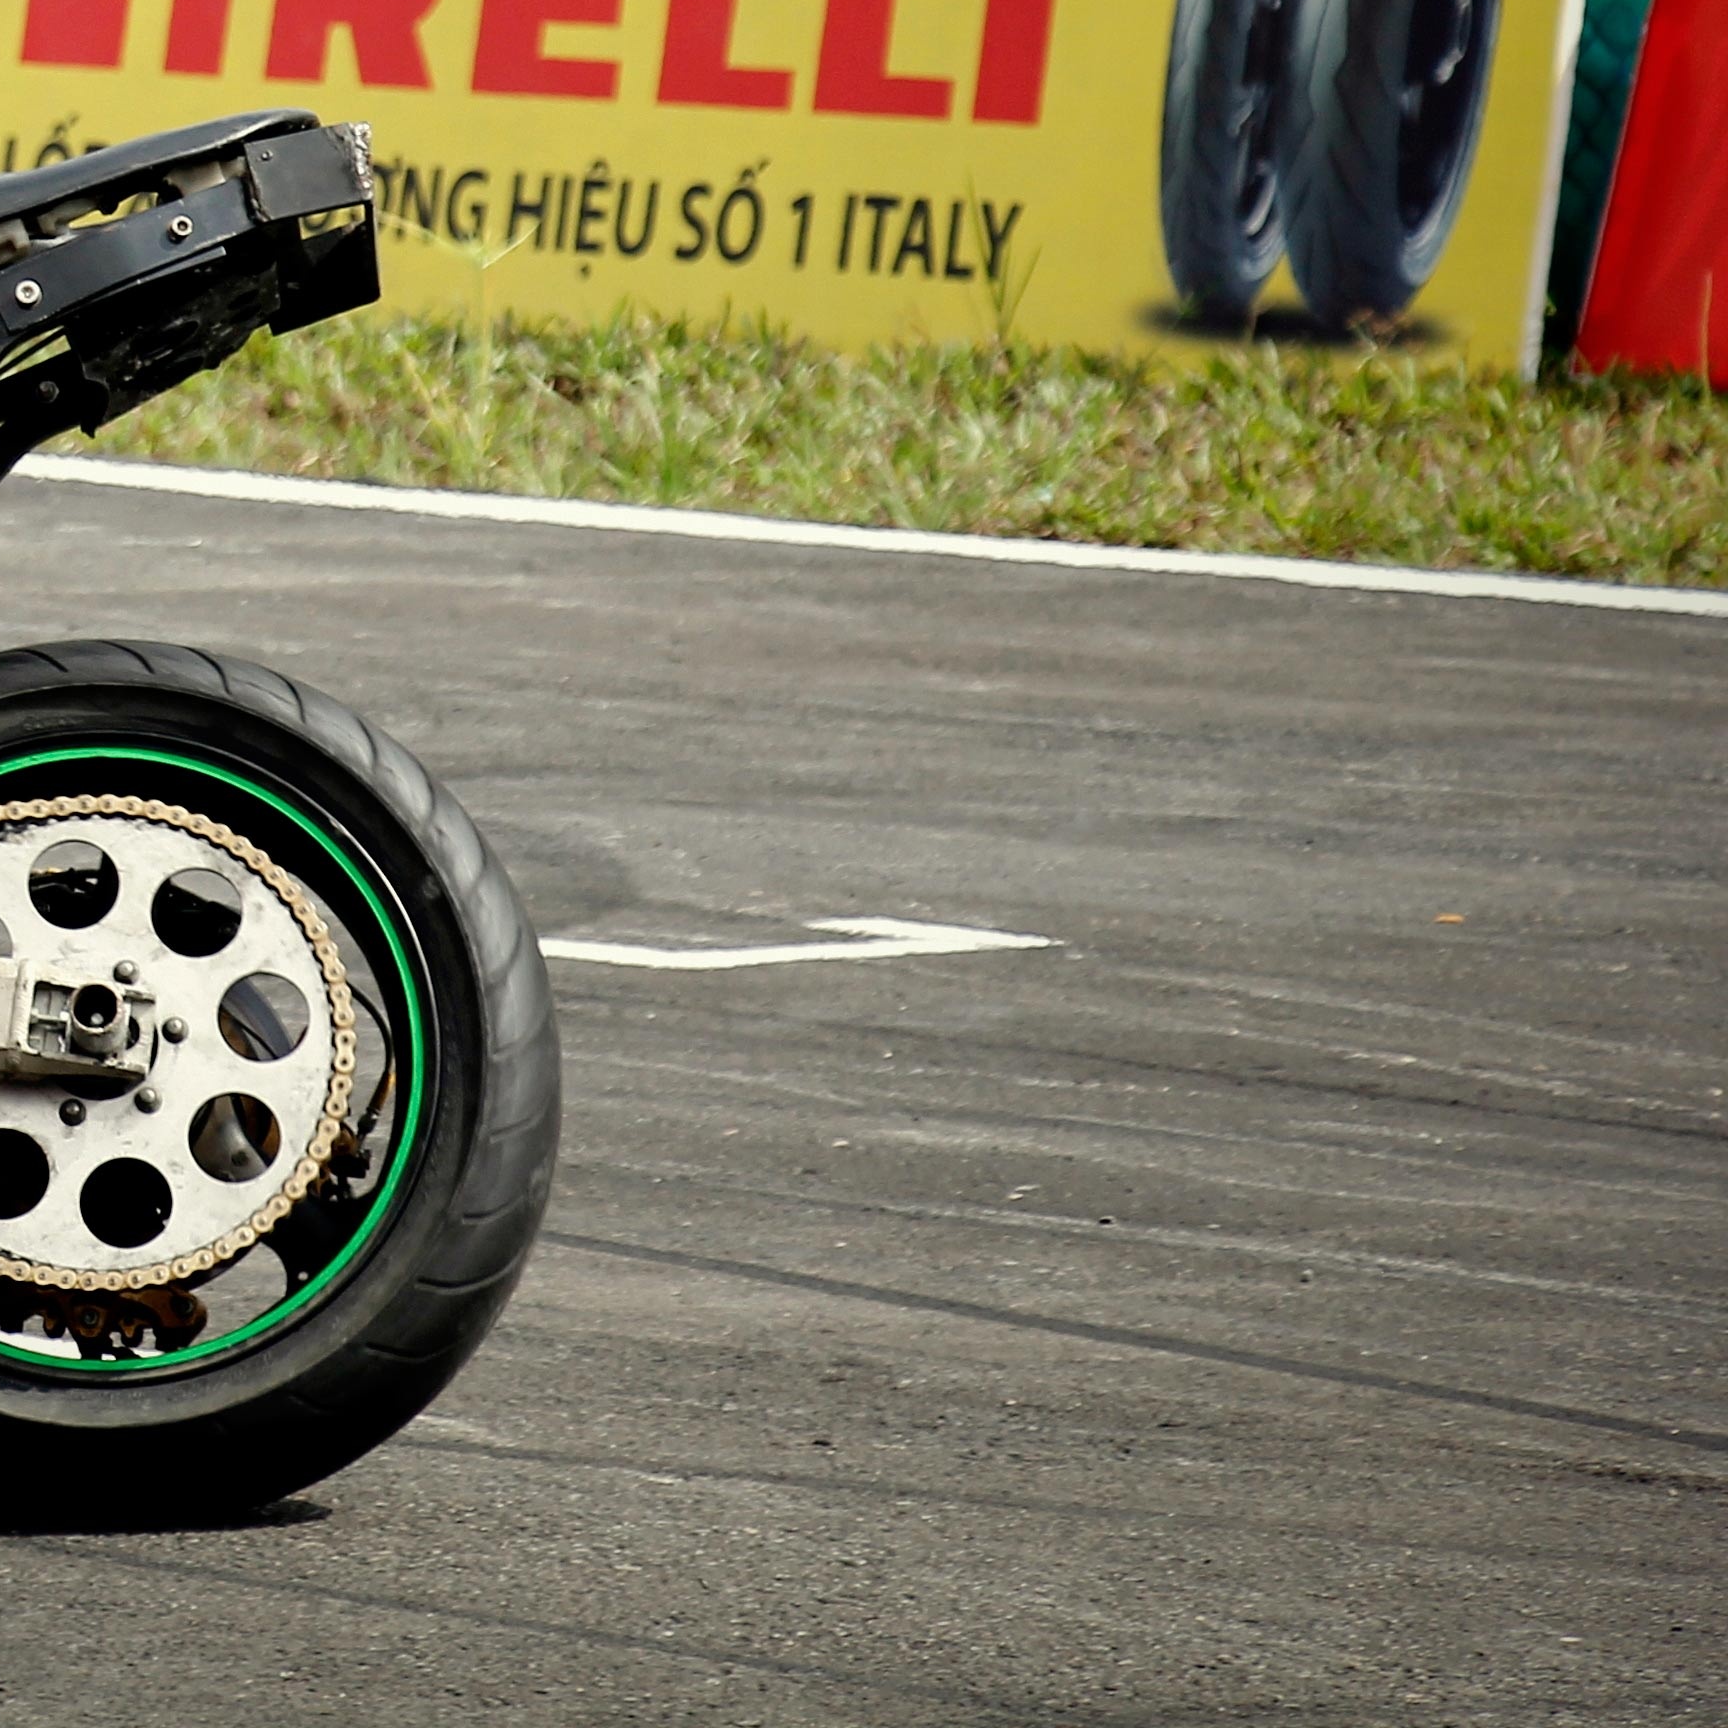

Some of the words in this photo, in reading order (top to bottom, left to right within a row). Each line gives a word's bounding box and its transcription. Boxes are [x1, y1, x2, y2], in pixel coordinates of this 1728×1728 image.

[505, 161, 659, 278] HIỆU
[673, 159, 771, 266] SỐ
[790, 193, 813, 268] 1
[836, 193, 1025, 286] ITALY
